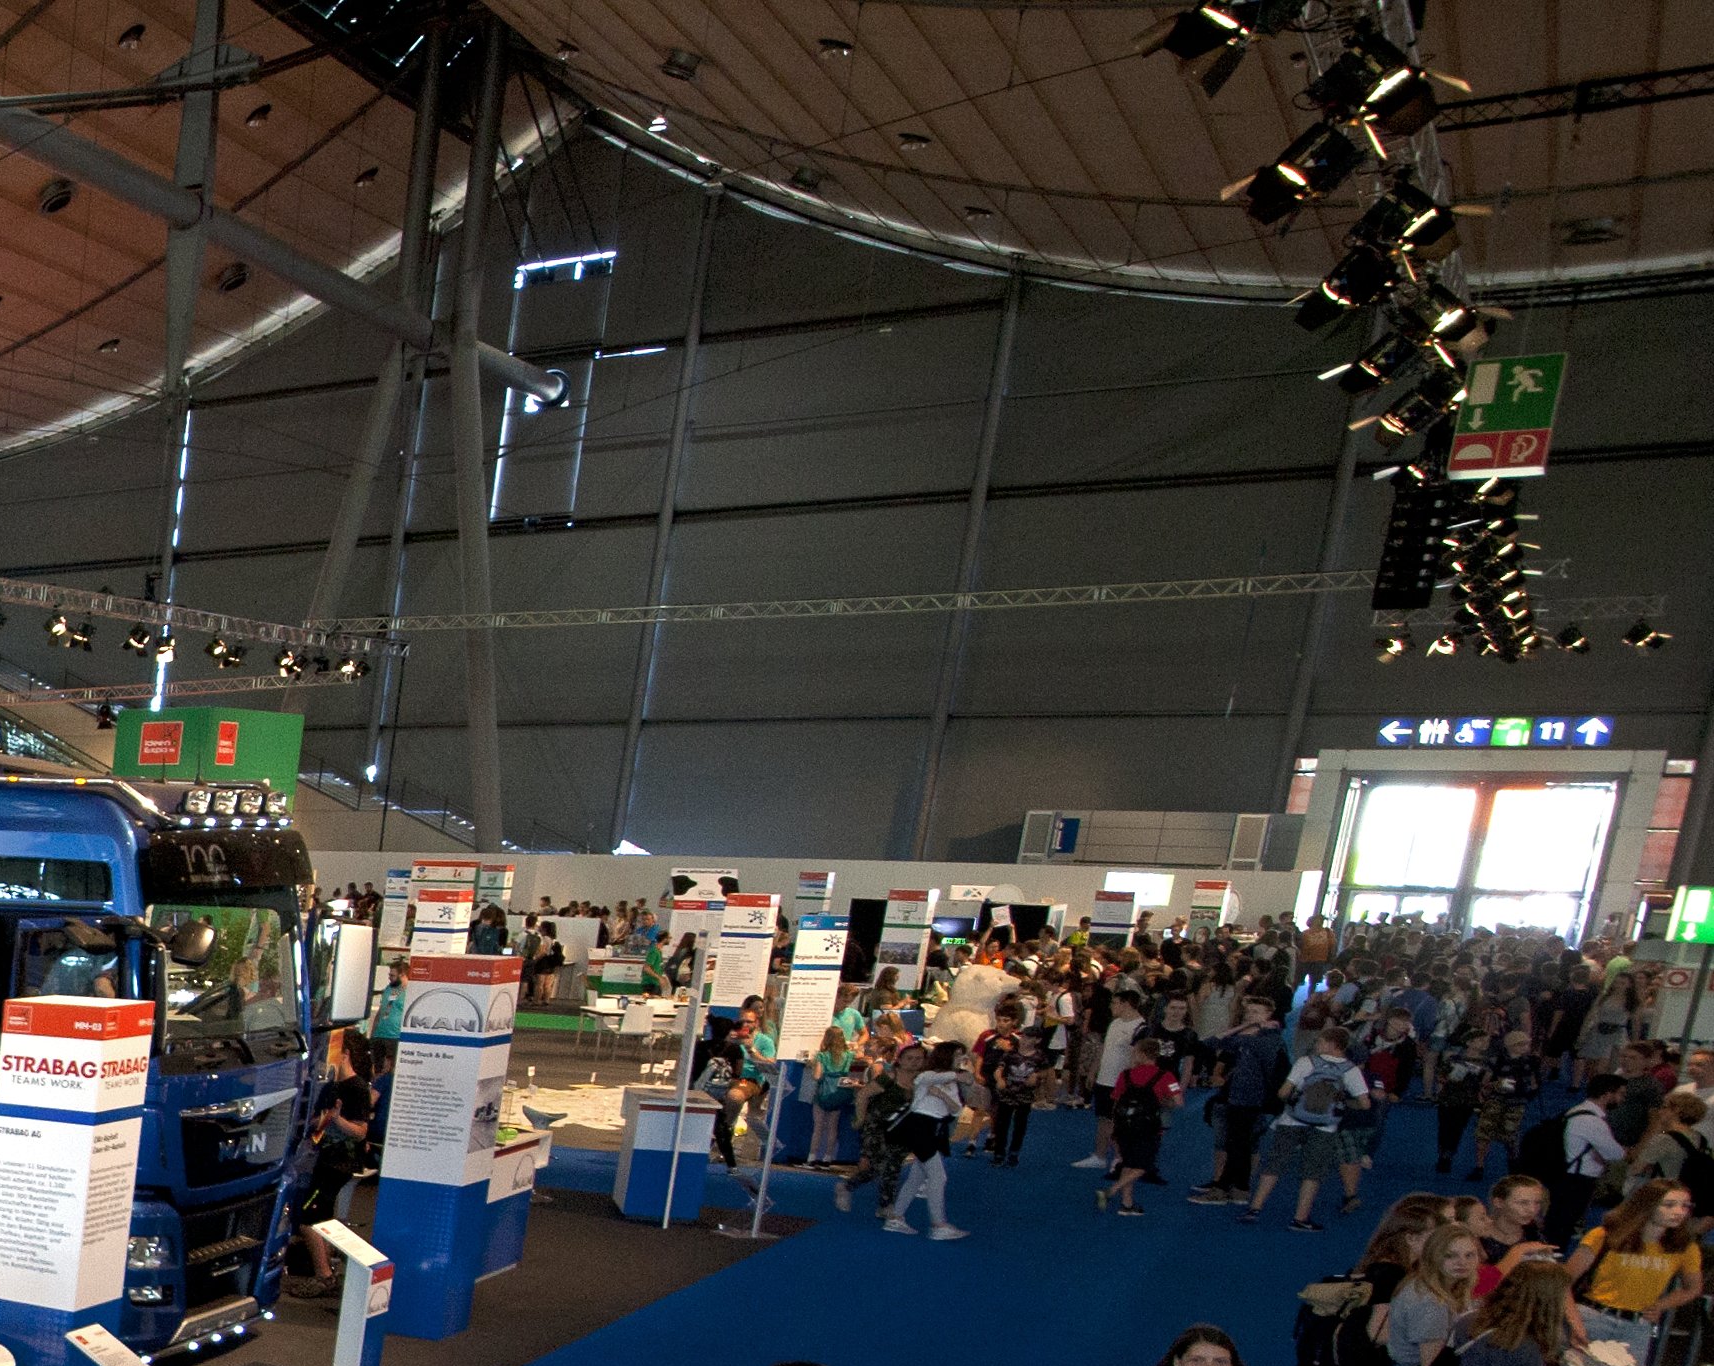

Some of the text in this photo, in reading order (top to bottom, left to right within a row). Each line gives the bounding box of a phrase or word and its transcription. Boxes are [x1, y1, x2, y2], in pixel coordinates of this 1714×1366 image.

[1540, 721, 1565, 740] 11
[410, 1015, 477, 1032] MAN
[2, 1054, 98, 1079] STRABAG
[100, 1056, 148, 1079] STRABAG
[12, 1075, 46, 1087] TEAMS
